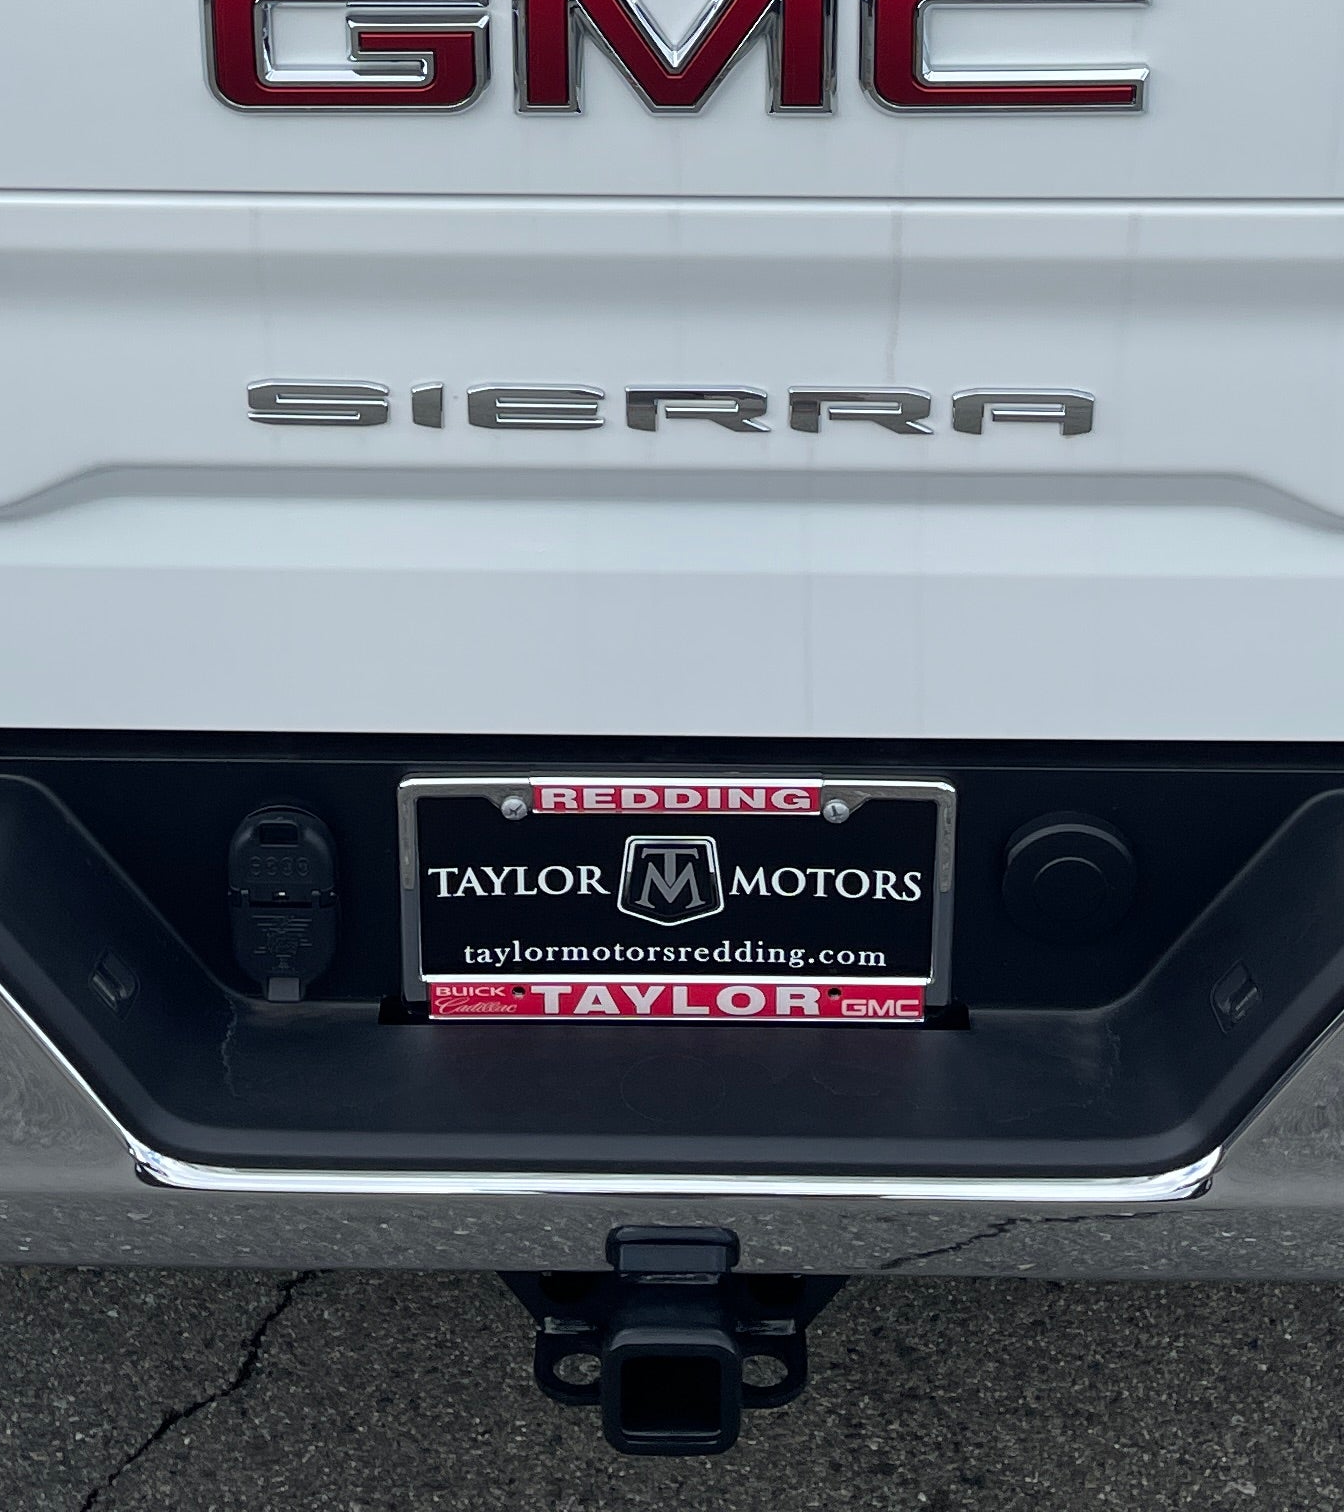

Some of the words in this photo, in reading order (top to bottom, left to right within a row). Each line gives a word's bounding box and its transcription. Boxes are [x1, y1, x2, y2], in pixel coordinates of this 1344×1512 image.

[246, 377, 1096, 437] SIERRA
[541, 787, 812, 811] REDDING
[428, 865, 611, 898] TAYLOR
[729, 865, 923, 902] MOTORS
[464, 939, 887, 968] taylormotorsredding.com
[434, 996, 518, 1015] Cadillac
[435, 986, 506, 997] BUICK
[531, 984, 821, 1016] TAYLOR
[841, 999, 920, 1017] GMC
